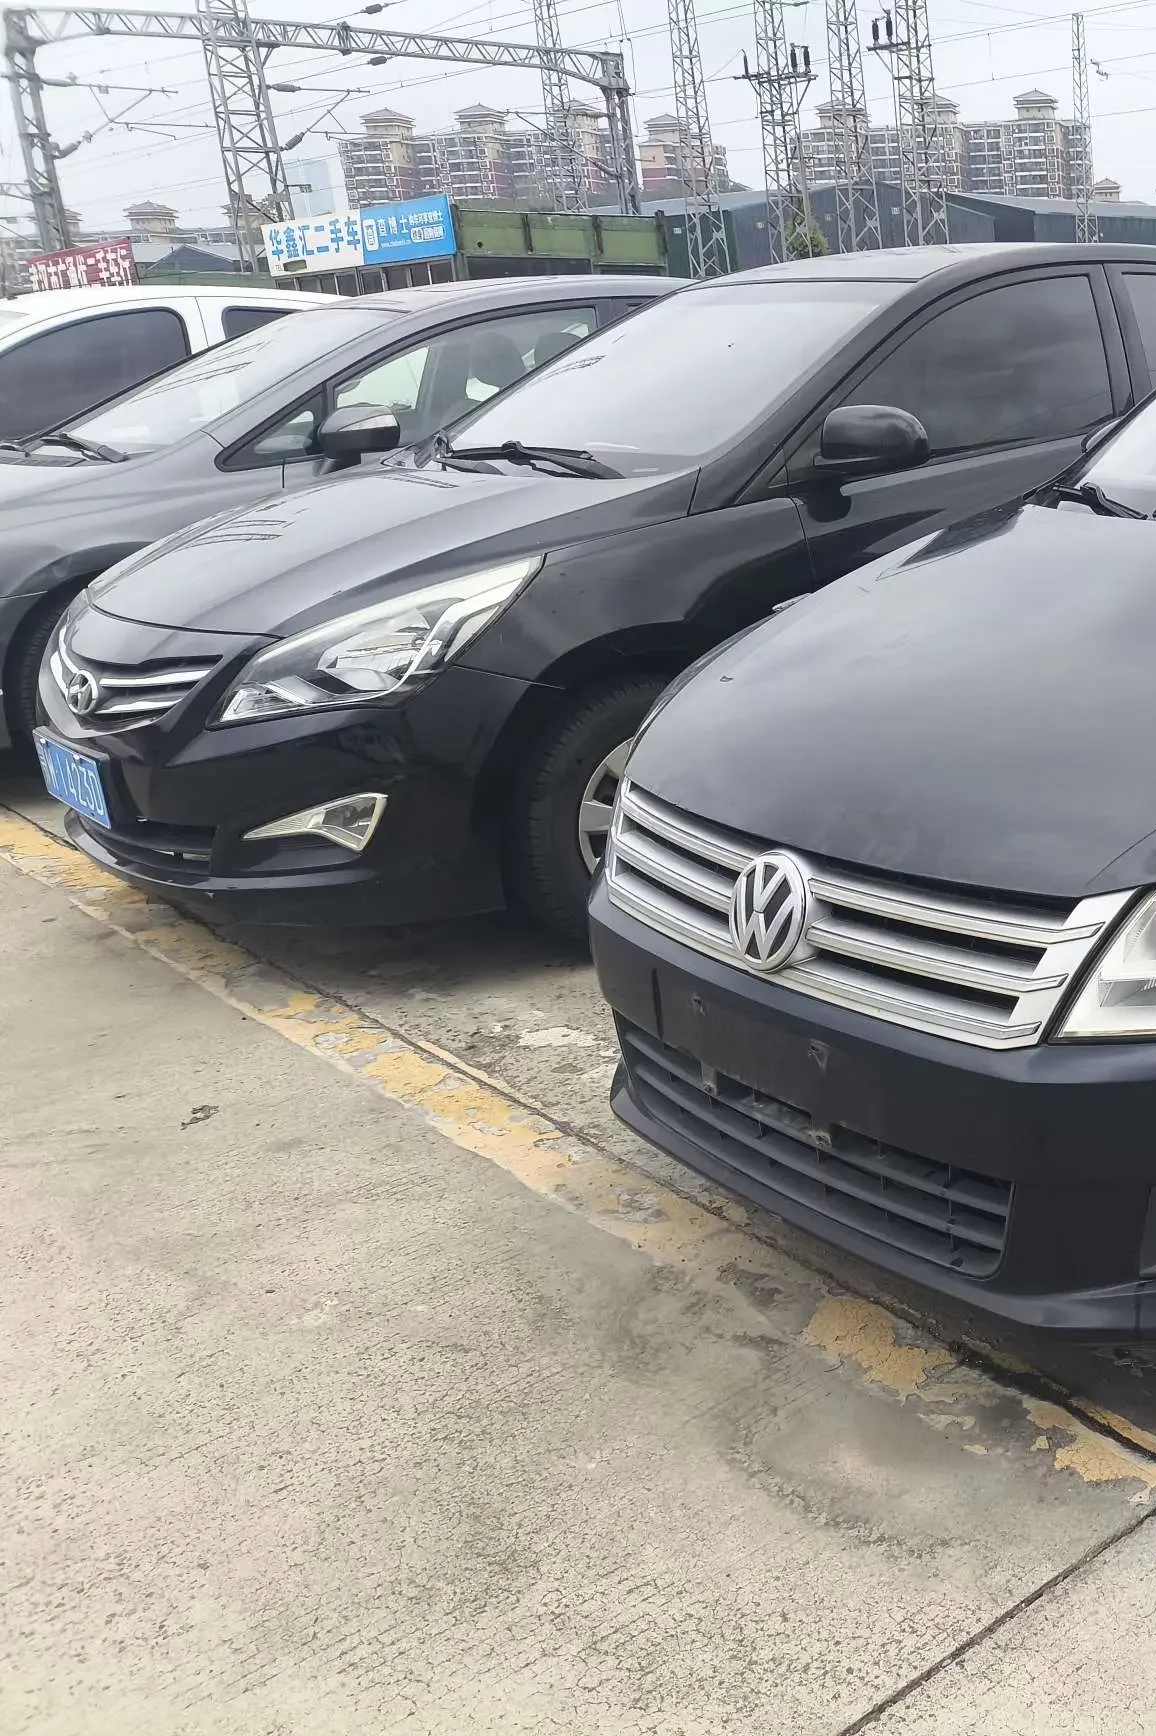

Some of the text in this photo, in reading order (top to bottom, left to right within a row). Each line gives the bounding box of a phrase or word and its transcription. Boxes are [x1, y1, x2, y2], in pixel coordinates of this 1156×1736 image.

[269, 216, 361, 261] 华鑫汇二手车
